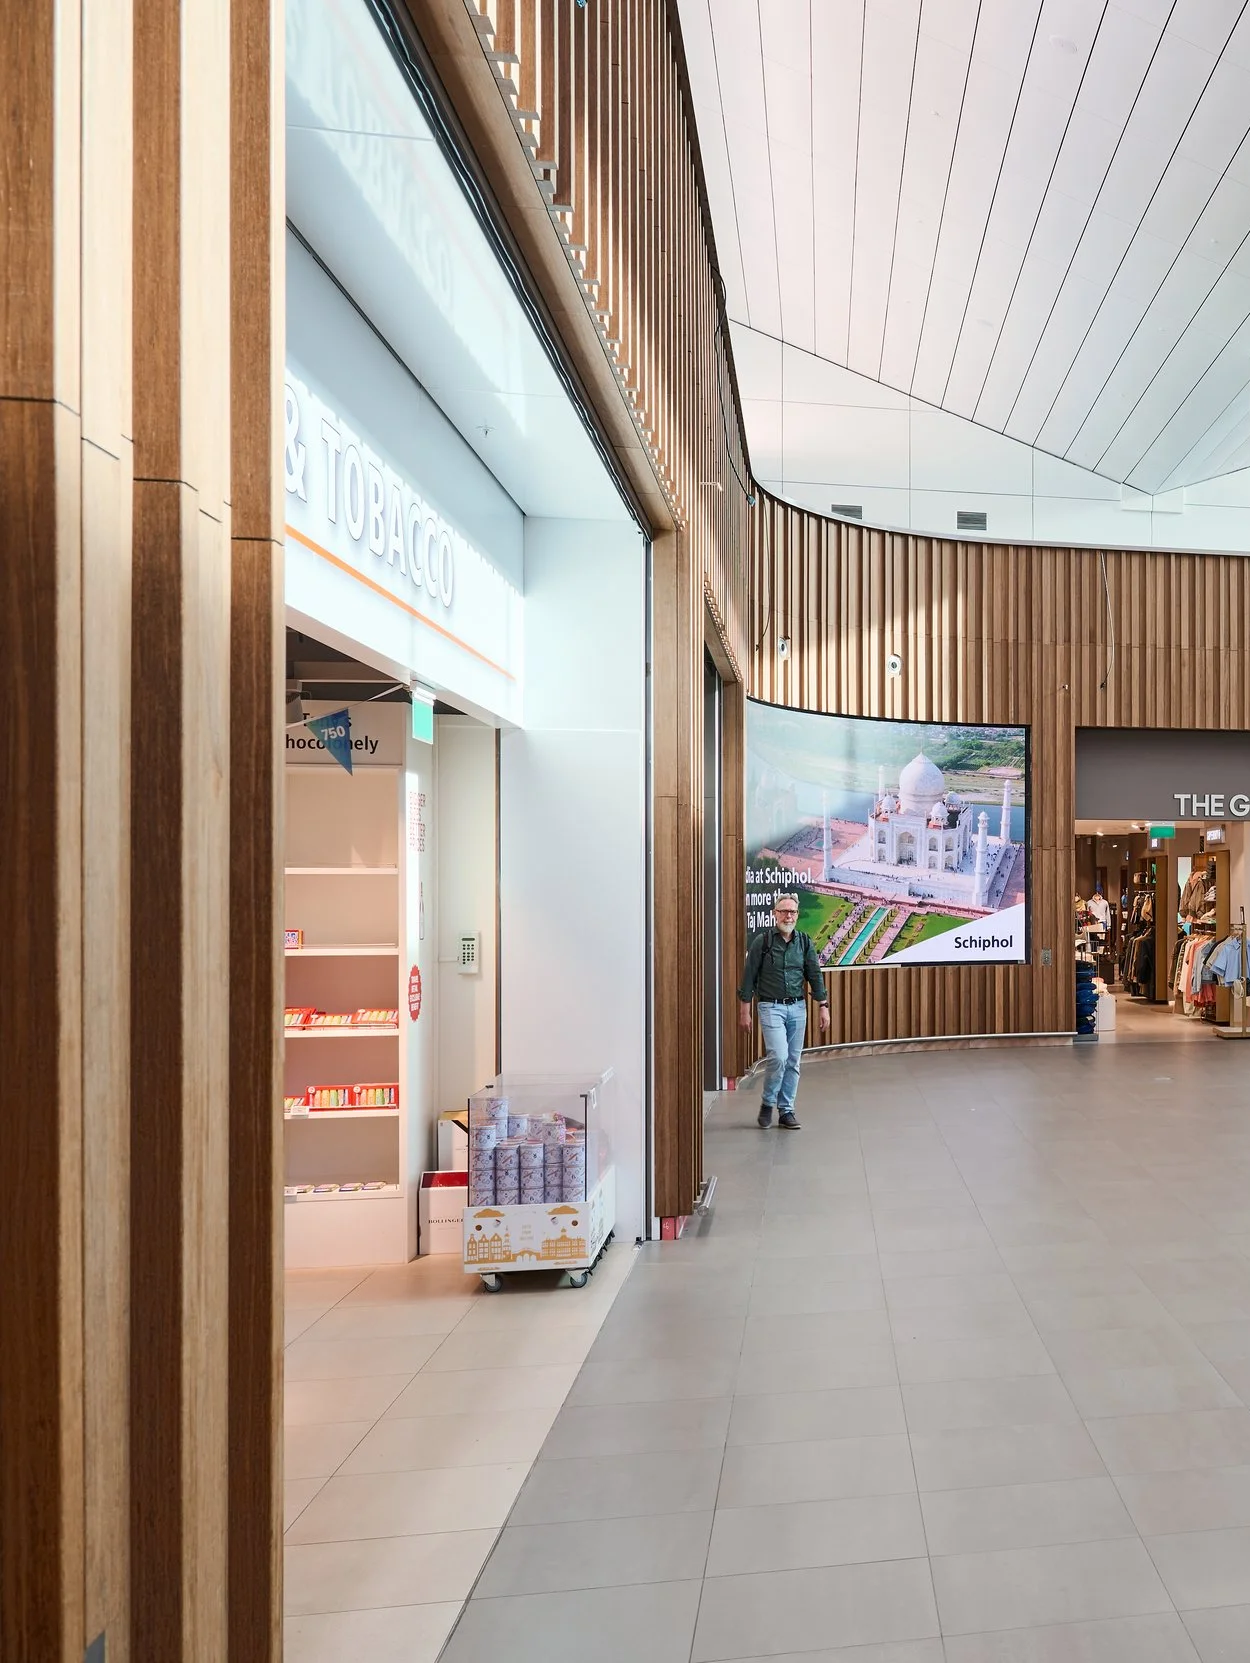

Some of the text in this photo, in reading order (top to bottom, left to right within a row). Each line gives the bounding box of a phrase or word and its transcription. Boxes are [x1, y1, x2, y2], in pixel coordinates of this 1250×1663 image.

[285, 384, 454, 608] & TOBACCO
[320, 725, 346, 741] 750
[1173, 794, 1225, 816] THE
[755, 868, 764, 884] at
[765, 866, 815, 888] Schiphol.
[751, 892, 772, 906] more
[747, 910, 778, 932] Taj Mah
[954, 934, 1013, 951] Schiphol
